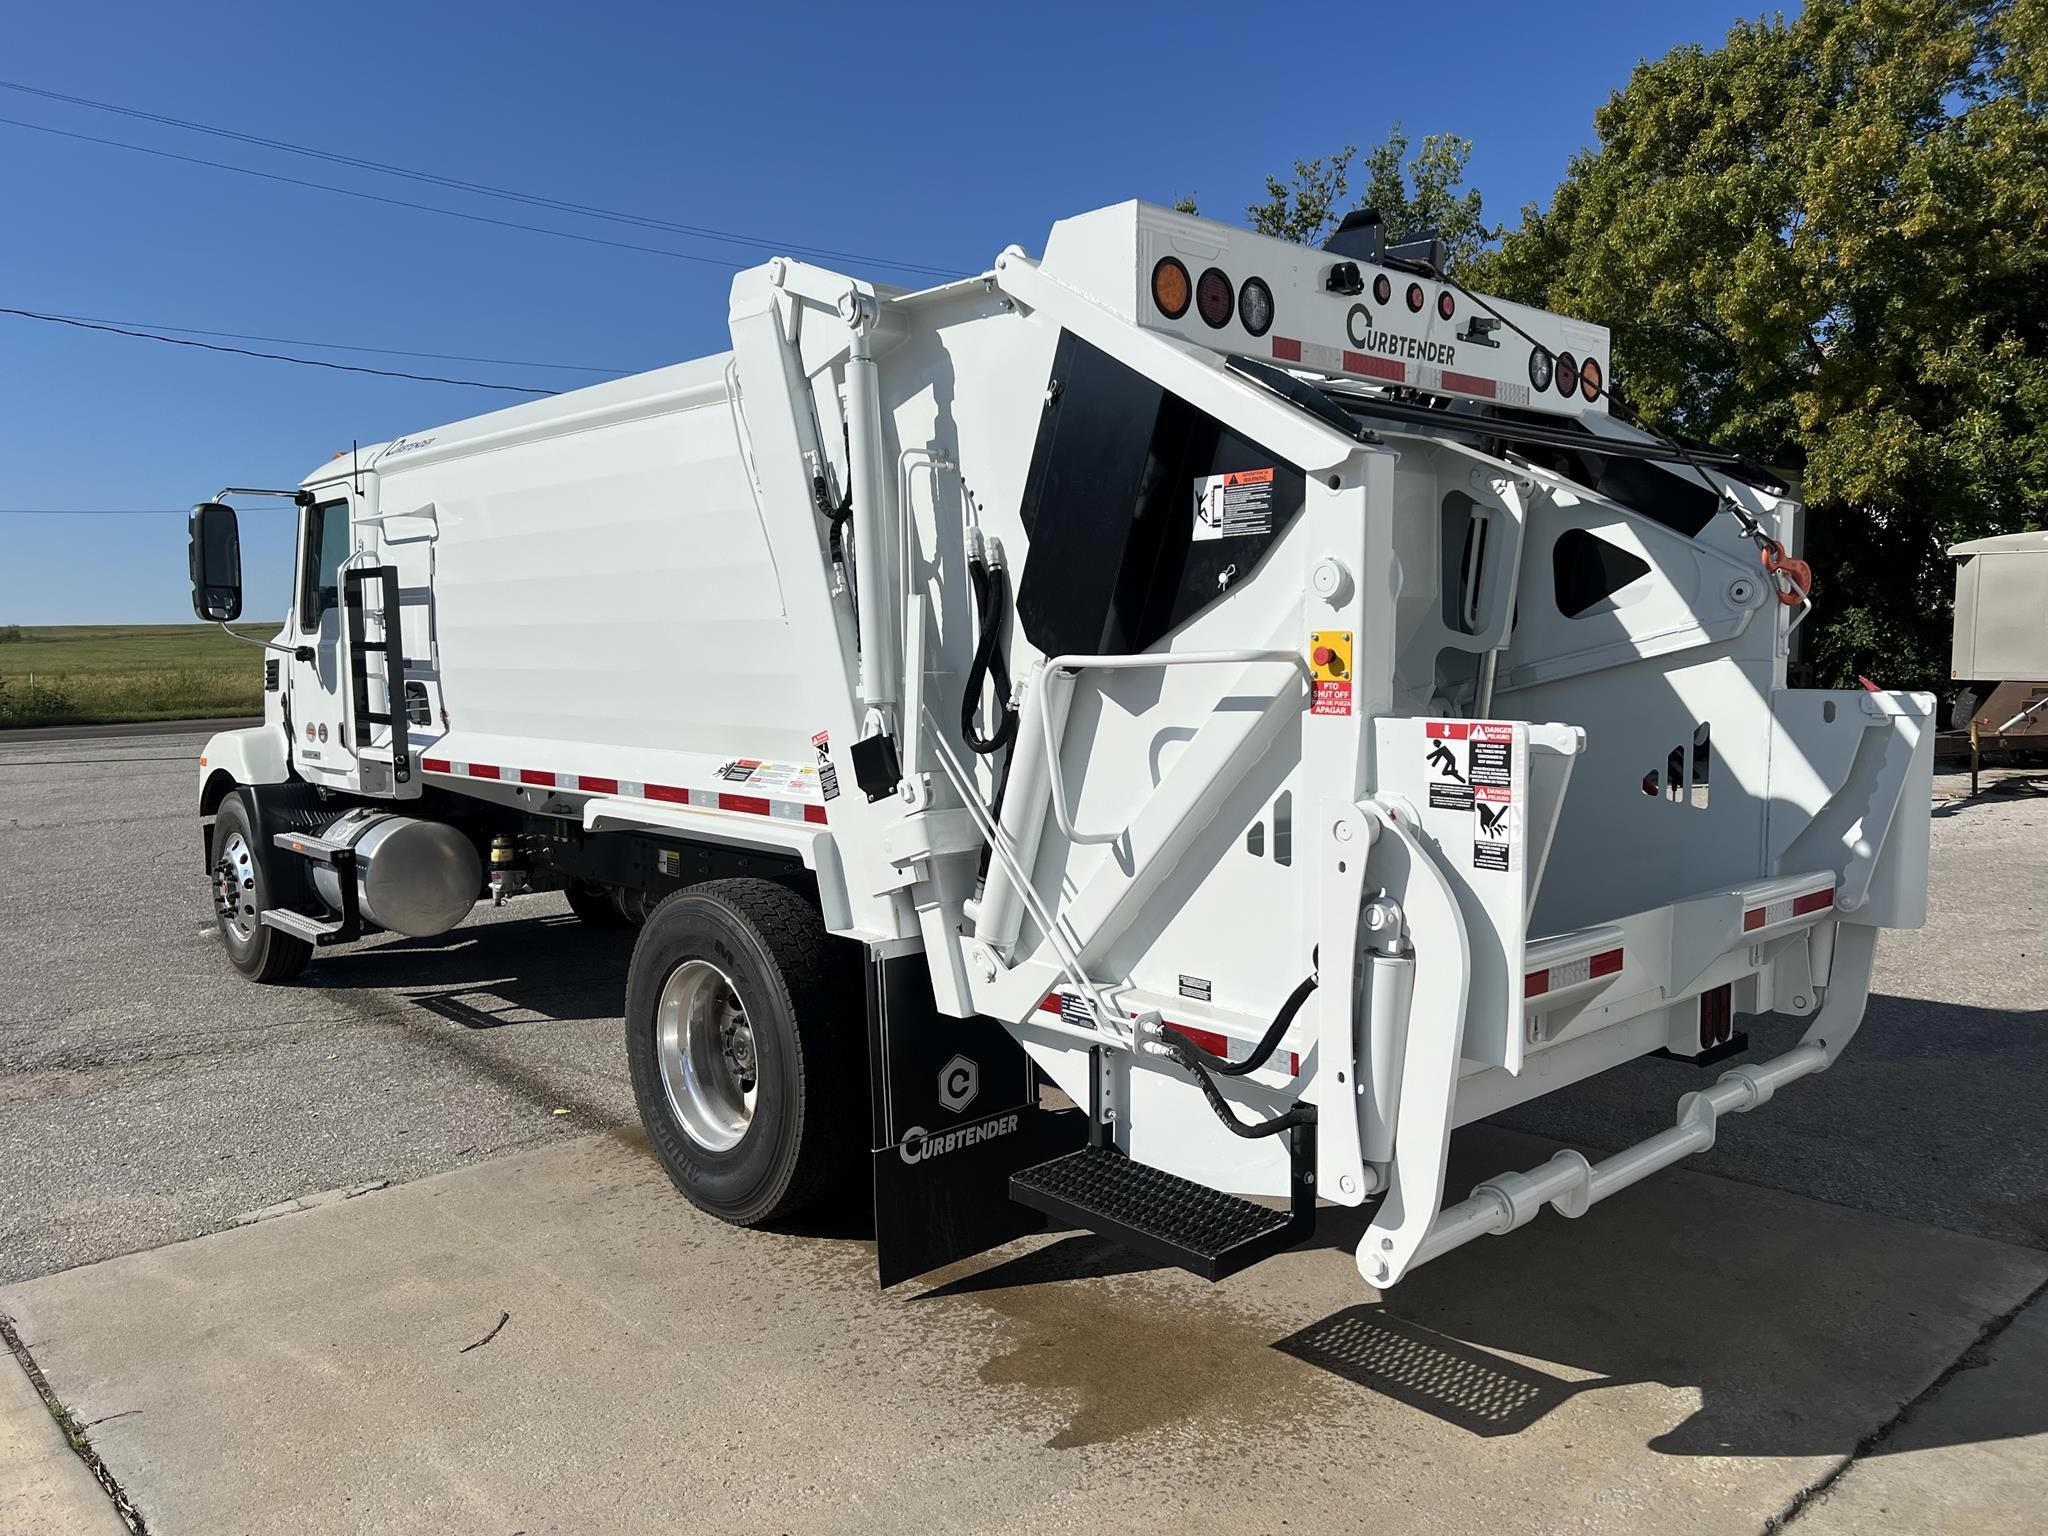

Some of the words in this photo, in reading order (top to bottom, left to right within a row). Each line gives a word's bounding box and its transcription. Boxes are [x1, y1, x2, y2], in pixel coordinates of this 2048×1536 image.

[1346, 303, 1455, 365] CURBTENDER
[1323, 682, 1339, 690] PTO
[1313, 690, 1333, 698] SHUT
[1334, 691, 1350, 699] OFF
[1315, 706, 1347, 714] APAGAR
[1485, 726, 1512, 734] DANGER
[1487, 788, 1511, 796] DANGER
[900, 1115, 1019, 1165] CURBTENDER
